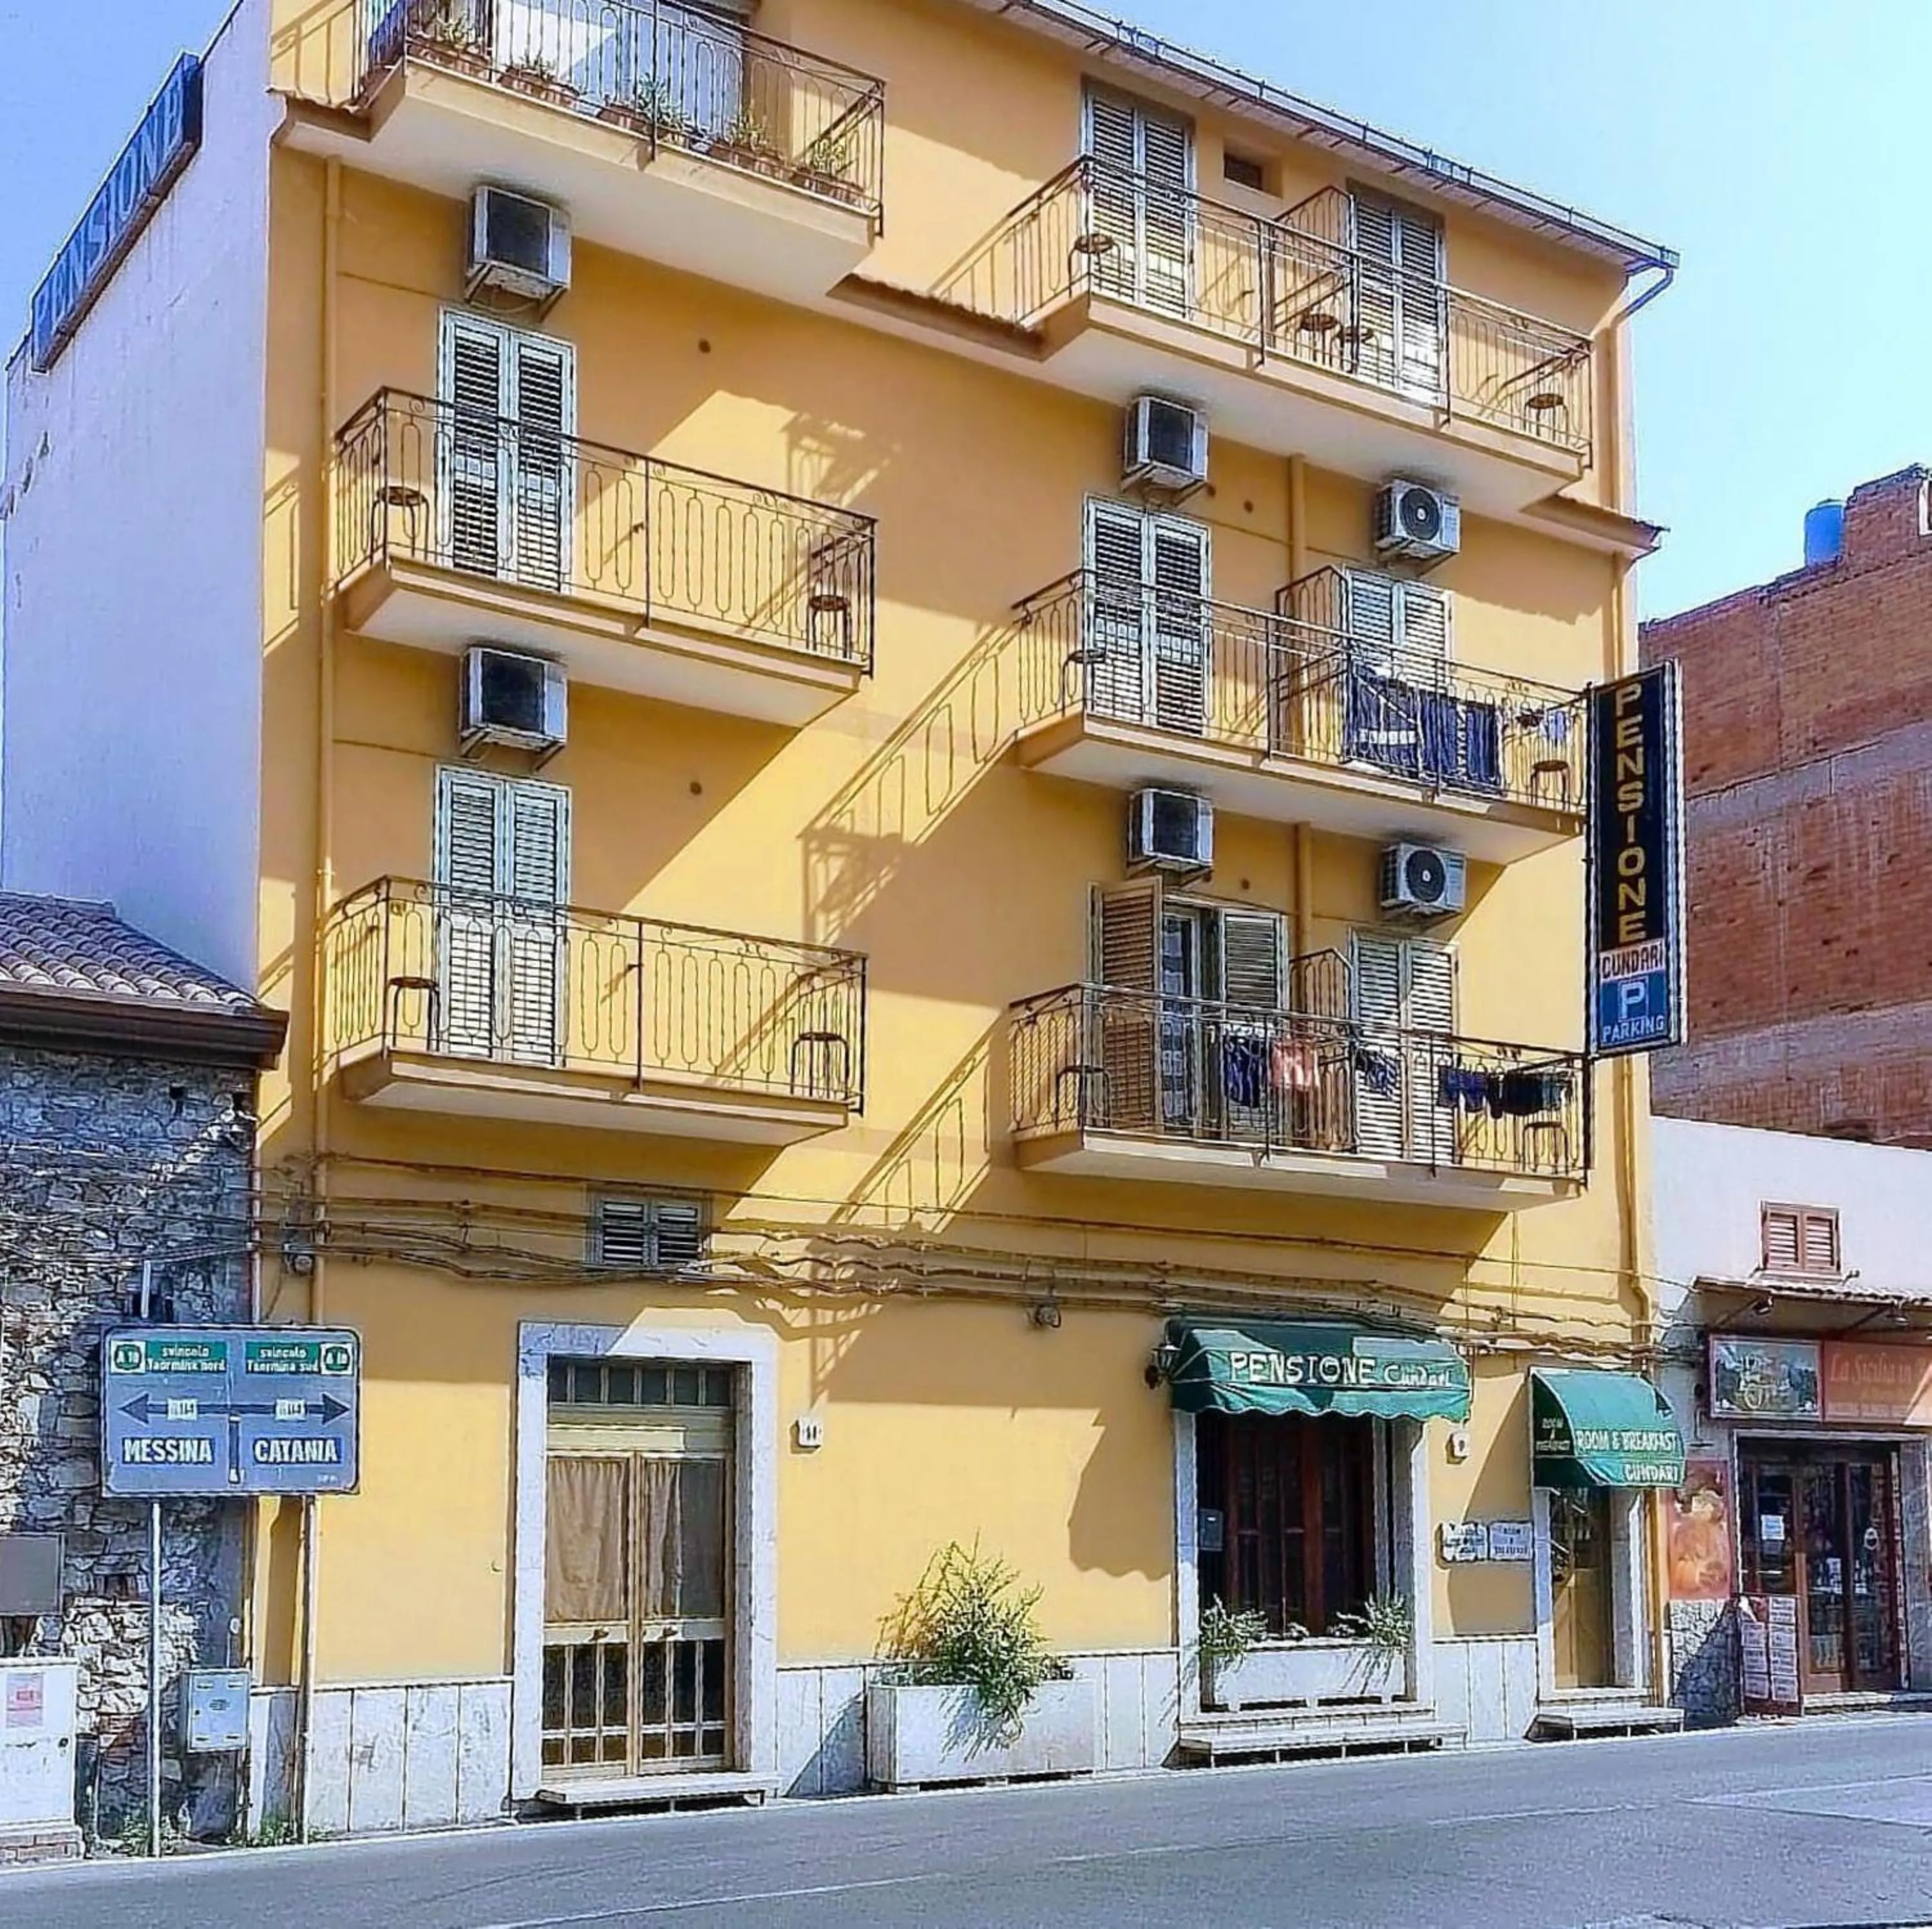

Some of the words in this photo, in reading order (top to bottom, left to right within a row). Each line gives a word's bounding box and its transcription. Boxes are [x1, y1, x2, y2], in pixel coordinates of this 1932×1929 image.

[1615, 682, 1646, 943] PENSIONE
[1621, 981, 1645, 1020] P
[1602, 1014, 1664, 1042] PARKING
[1229, 1351, 1376, 1385] PENSIONE
[124, 1439, 213, 1463] MESSINA
[255, 1439, 337, 1463] CATANIA
[1575, 1429, 1609, 1450] ROOM
[1621, 1430, 1678, 1451] BREAKFAST
[1624, 1463, 1678, 1482] CUNDARI
